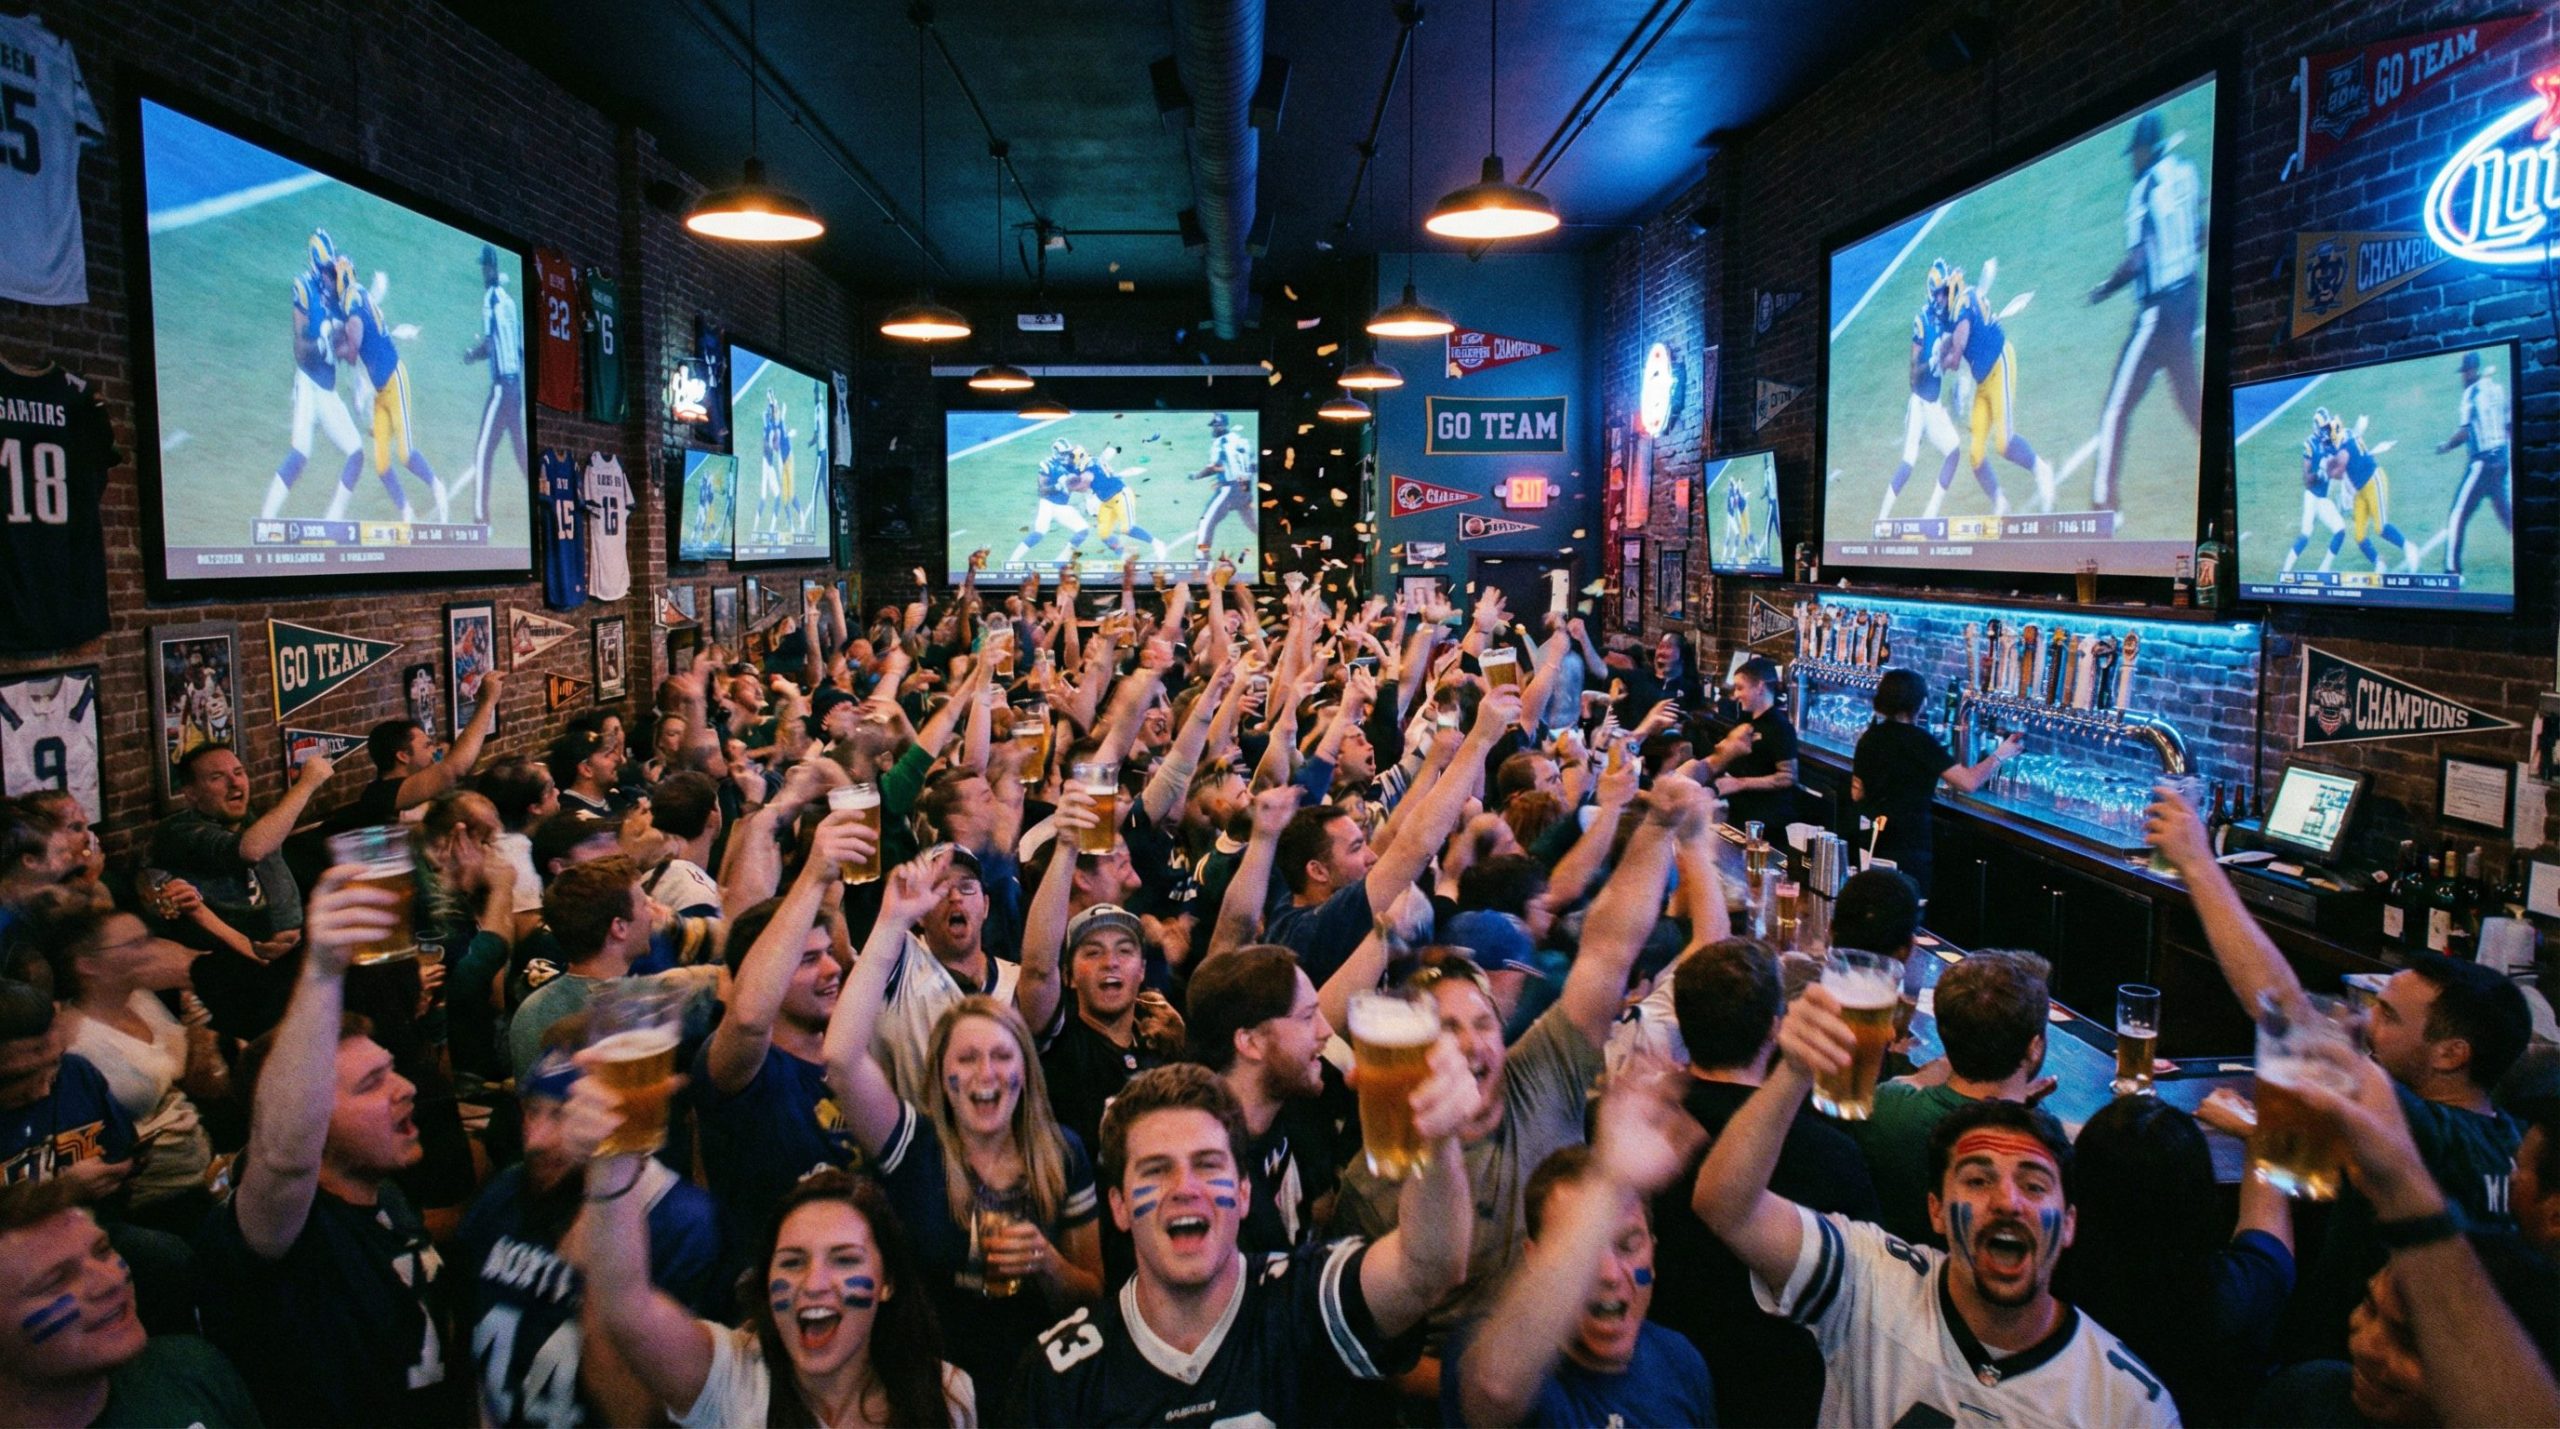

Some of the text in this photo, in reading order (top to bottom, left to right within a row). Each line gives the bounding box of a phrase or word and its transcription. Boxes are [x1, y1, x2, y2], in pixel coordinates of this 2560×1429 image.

[2374, 28, 2478, 107] GO TEAM
[2358, 240, 2444, 292] CHAMPIO
[548, 296, 570, 341] 22
[1438, 412, 1557, 439] GO TEAM
[0, 437, 68, 525] 18
[280, 642, 369, 692] GO TEAM
[2355, 677, 2469, 730] CHAMPIONS
[33, 736, 68, 797] 9
[1037, 1306, 1104, 1373] 13
